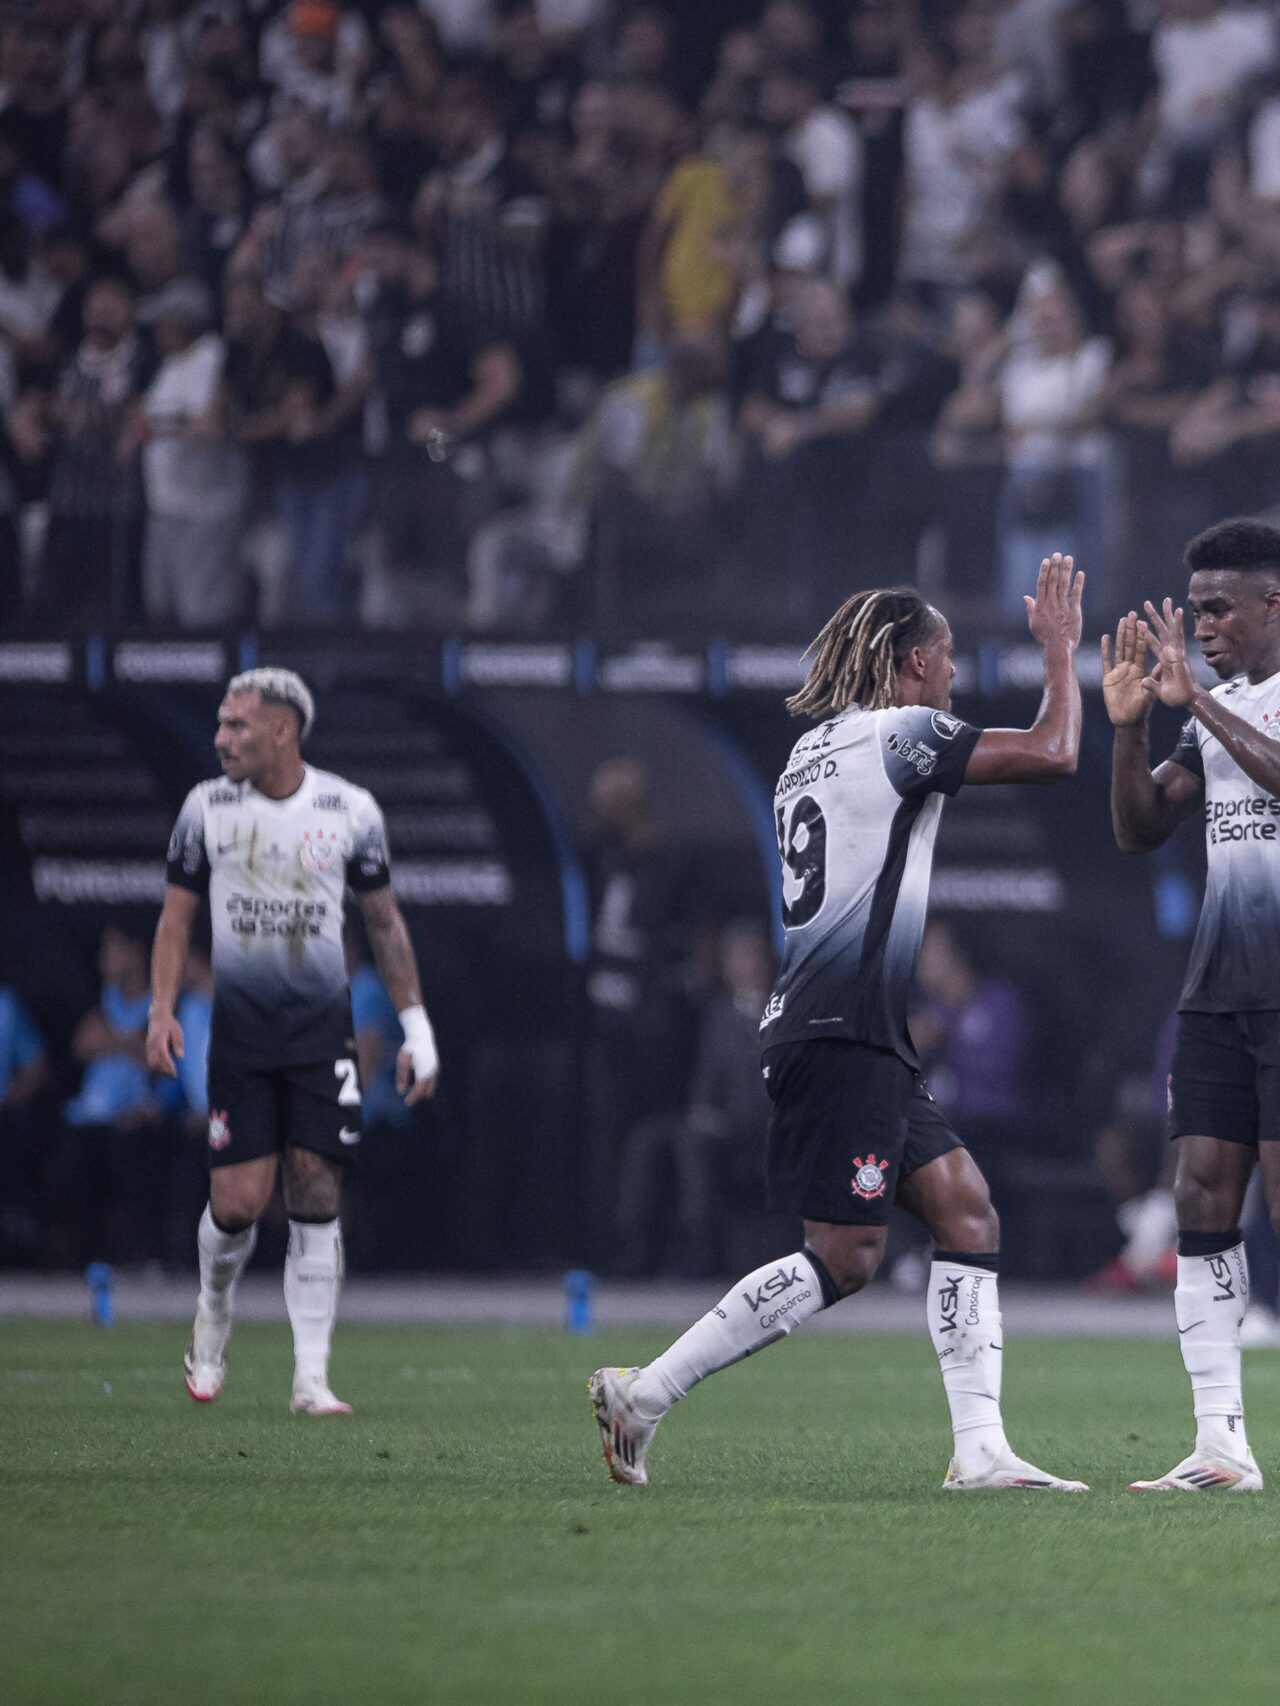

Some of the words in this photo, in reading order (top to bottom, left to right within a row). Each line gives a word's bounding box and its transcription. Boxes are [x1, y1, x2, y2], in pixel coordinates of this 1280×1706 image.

[824, 760, 839, 779] D.
[1219, 820, 1276, 843] Sorte
[334, 1058, 361, 1107] 2
